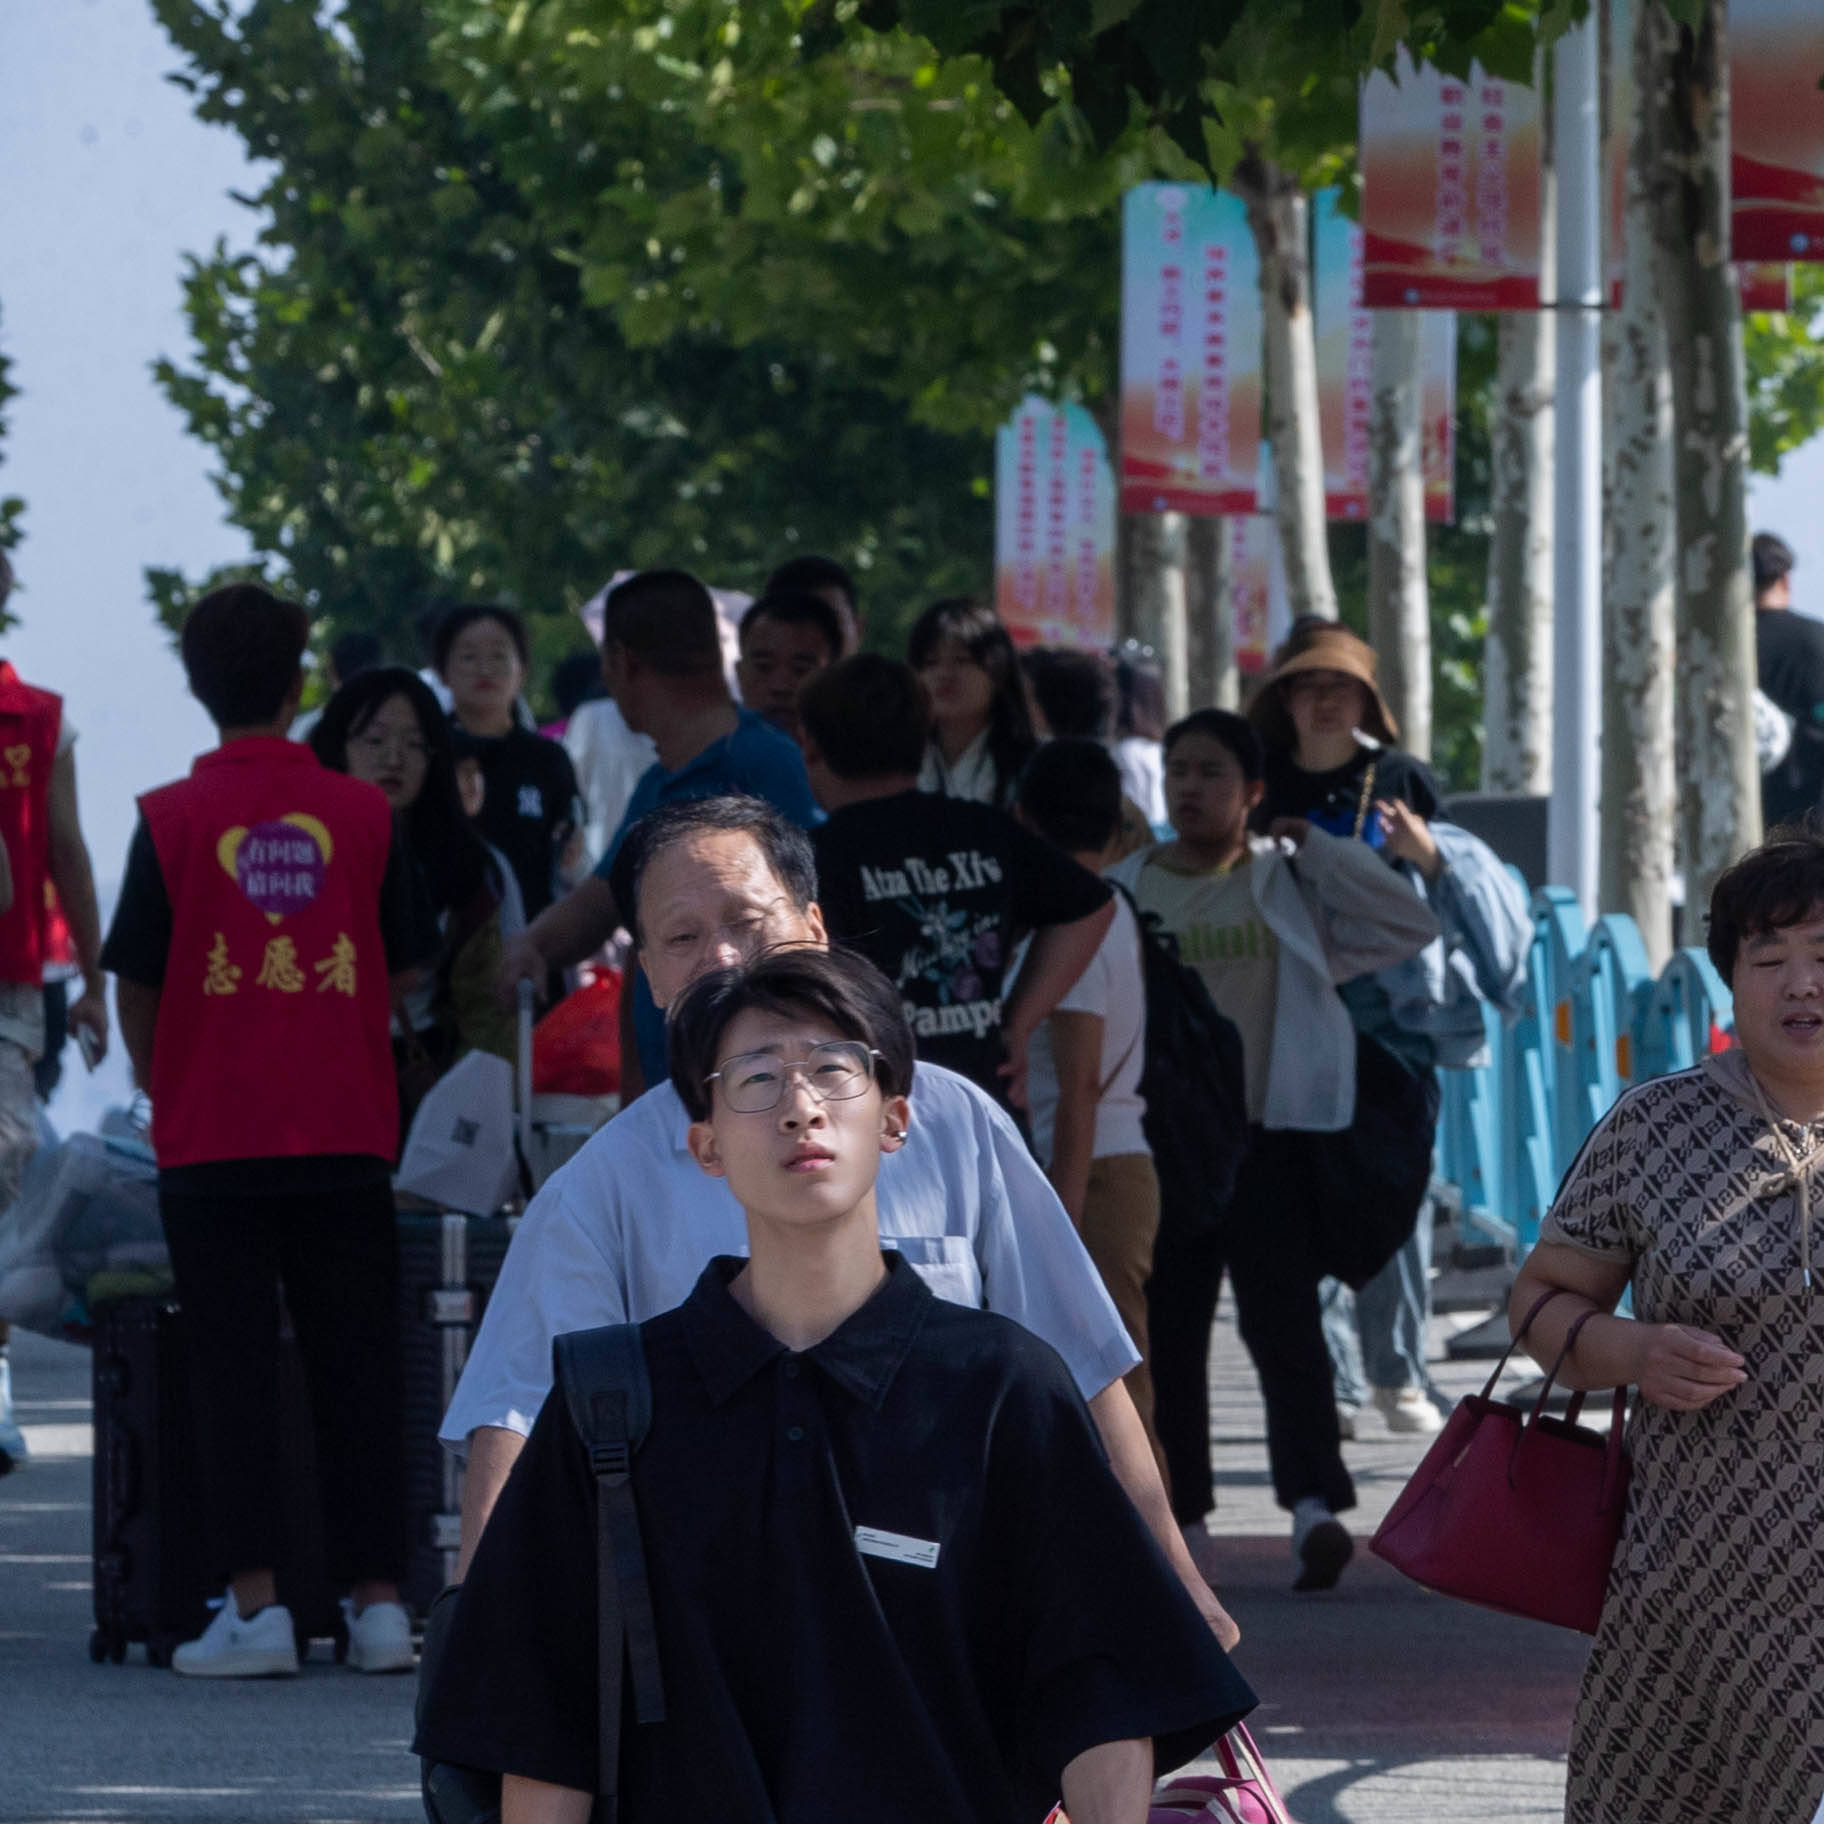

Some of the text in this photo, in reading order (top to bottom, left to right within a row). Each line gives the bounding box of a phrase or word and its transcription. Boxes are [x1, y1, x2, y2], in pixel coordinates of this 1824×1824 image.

[247, 838, 315, 865] 有问题
[246, 871, 317, 898] 请问我
[203, 931, 358, 997] 志愿者
